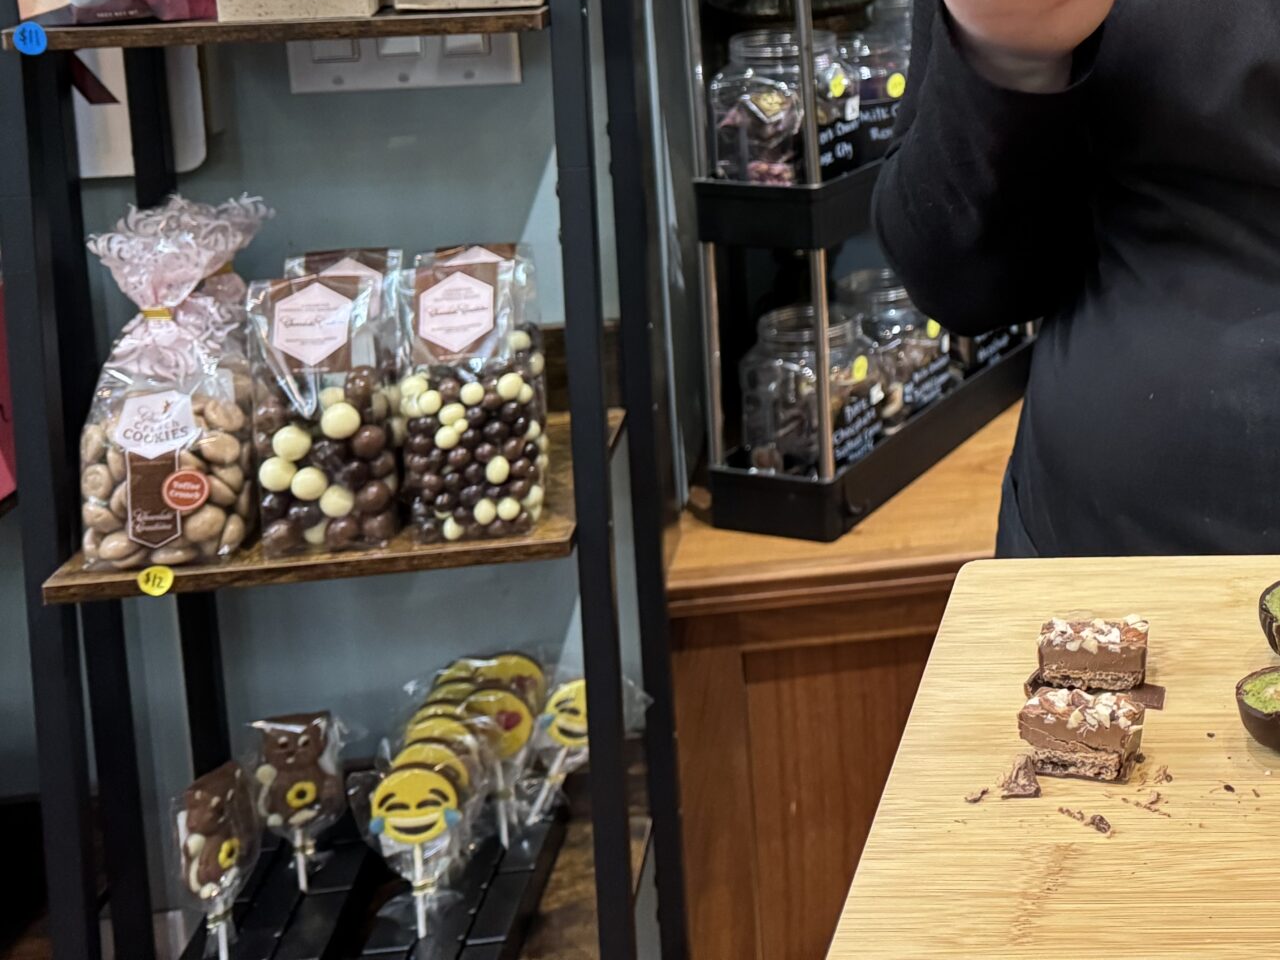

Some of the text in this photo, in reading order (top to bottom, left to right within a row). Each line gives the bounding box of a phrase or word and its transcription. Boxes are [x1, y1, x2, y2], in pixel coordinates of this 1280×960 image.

[19, 28, 41, 45] $11
[122, 425, 189, 444] COOKIES
[143, 571, 166, 584] $12
